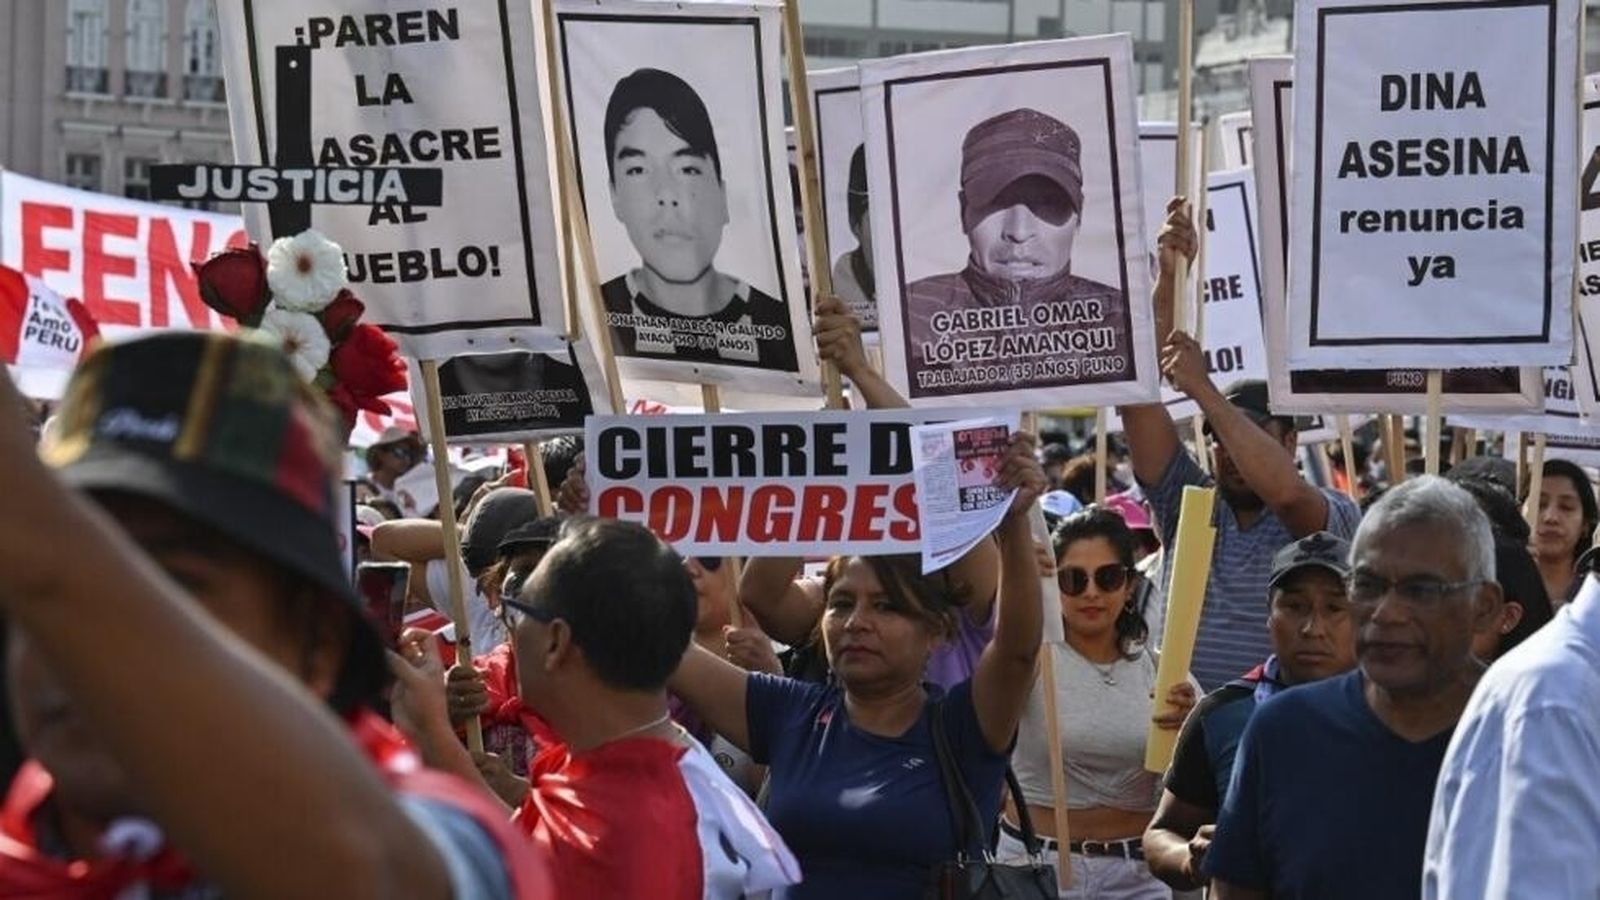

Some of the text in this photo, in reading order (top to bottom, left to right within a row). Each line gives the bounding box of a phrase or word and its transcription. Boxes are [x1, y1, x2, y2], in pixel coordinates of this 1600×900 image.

[355, 73, 414, 106] LA
[1381, 71, 1486, 111] DINA
[317, 127, 502, 167] ASACRE
[1338, 136, 1530, 178] ASESINA
[178, 166, 408, 202] JUSTICIA
[368, 203, 428, 226] AL
[1340, 199, 1524, 233] renuncia
[342, 246, 500, 283] UEBLO!
[1407, 254, 1455, 287] ya
[29, 311, 72, 333] Amo
[727, 322, 785, 340] GALINDO
[932, 300, 1102, 334] GABRIEL OMAR
[638, 331, 697, 347] AYACUCHO
[923, 327, 1114, 364] LÓPEZ AMANQUI
[917, 366, 1008, 388] TRABAJADOR
[1035, 357, 1080, 380] AÑOS)
[1083, 355, 1125, 374] PUNO
[597, 423, 848, 479] CIERRE
[869, 421, 914, 475] D
[597, 483, 922, 543] CONGRES
